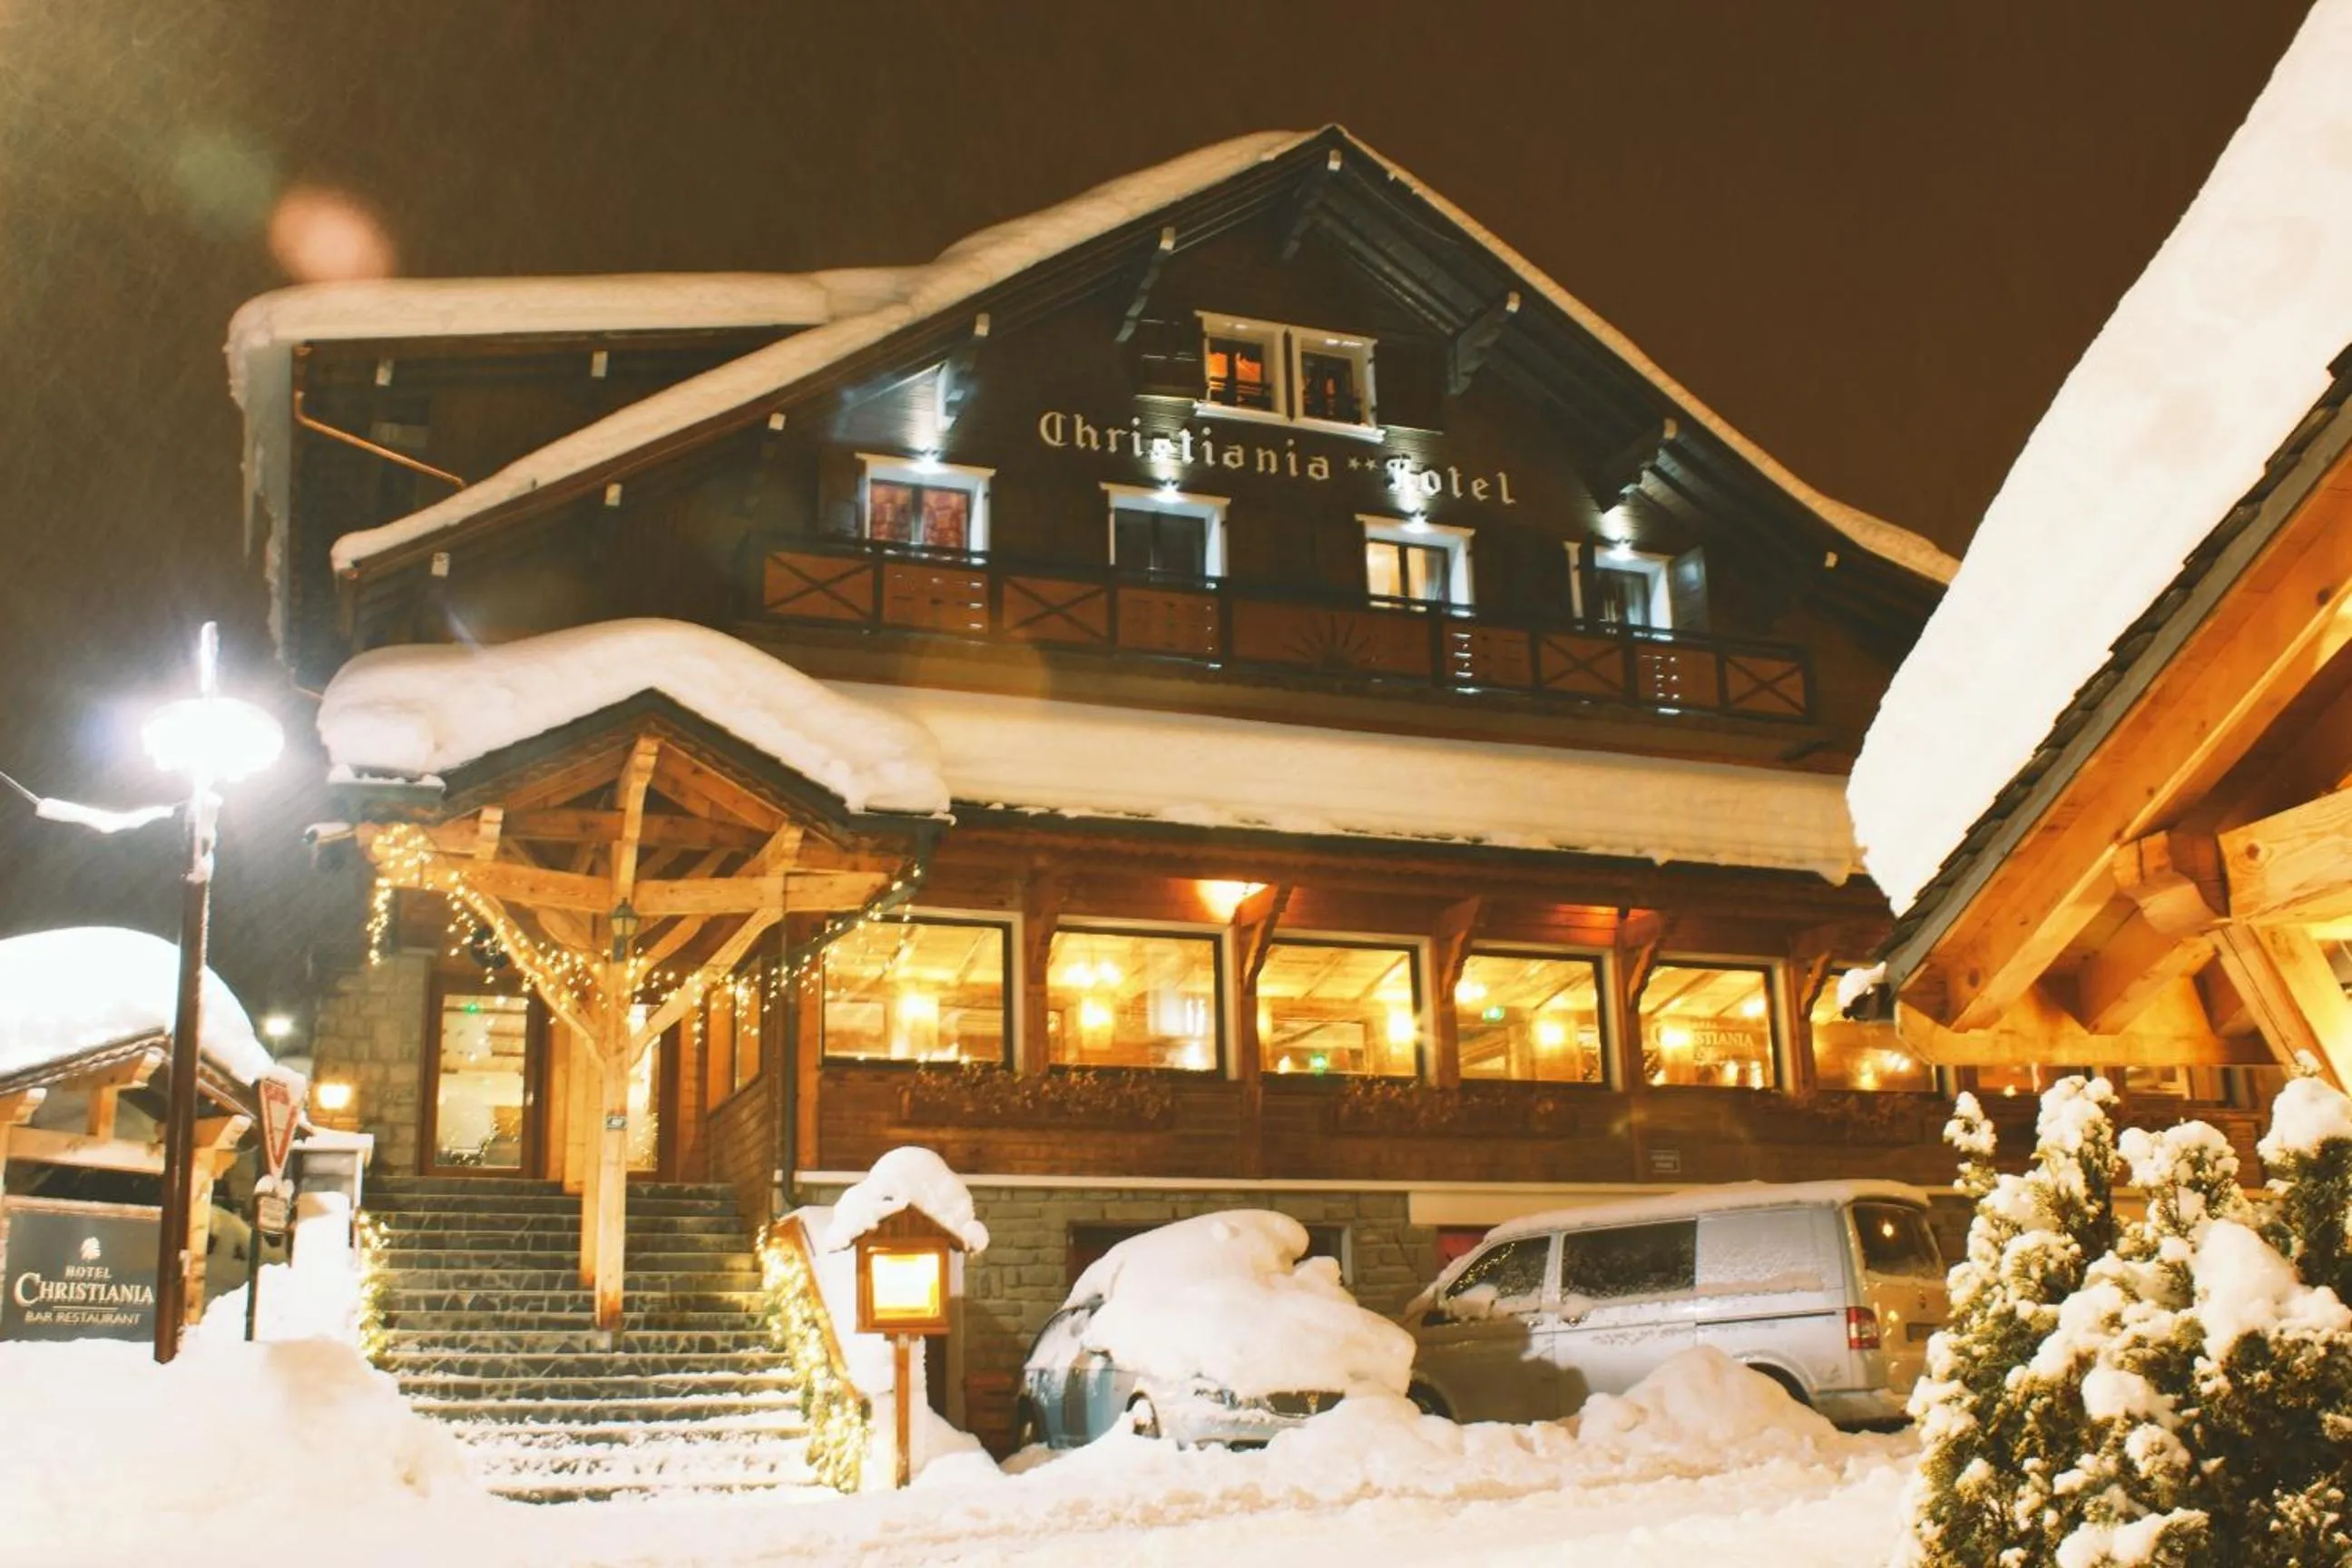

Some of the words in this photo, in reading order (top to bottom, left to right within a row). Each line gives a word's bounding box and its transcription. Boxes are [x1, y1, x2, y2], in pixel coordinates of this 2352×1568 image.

[64, 1264, 112, 1279] HOTEL
[15, 1271, 155, 1307] CHRISTIANIA
[24, 1310, 53, 1324] BAR
[55, 1311, 141, 1325] RESTAURANT
